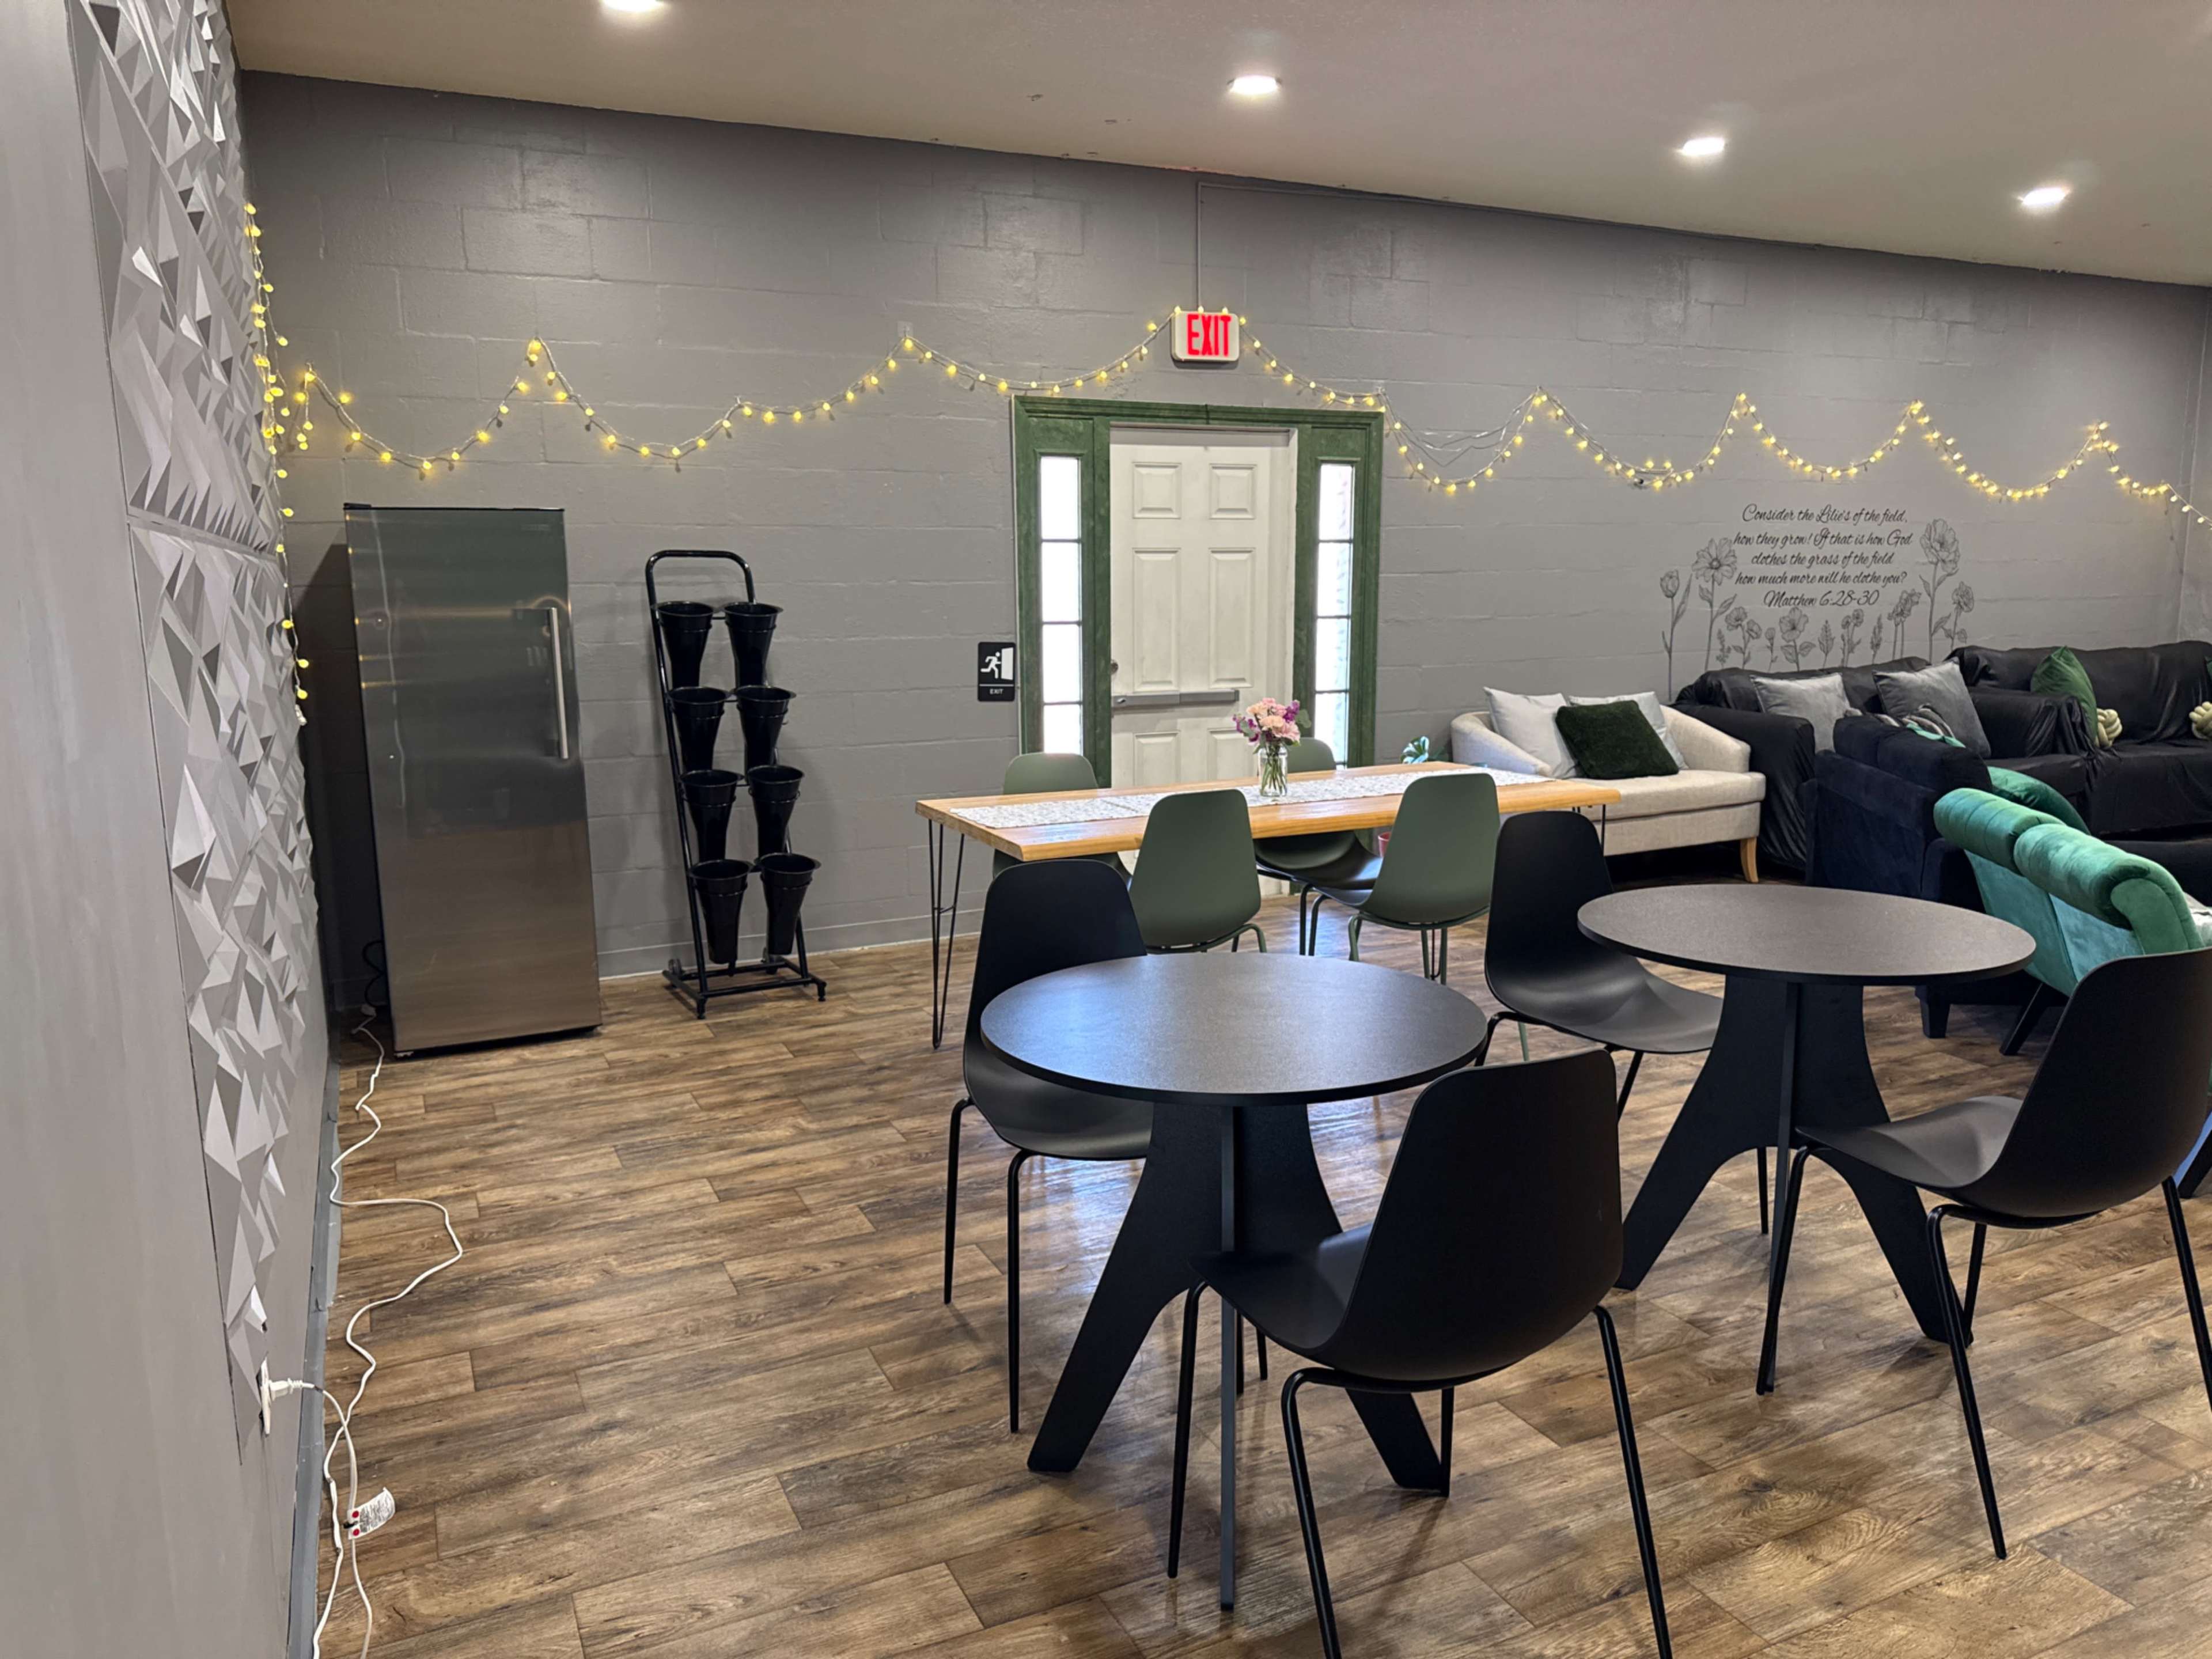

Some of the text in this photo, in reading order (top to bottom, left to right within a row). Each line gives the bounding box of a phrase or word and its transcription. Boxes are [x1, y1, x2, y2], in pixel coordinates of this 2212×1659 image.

[1187, 313, 1232, 357] EXIT
[1742, 503, 1796, 522] Consider
[1797, 508, 1815, 521] the
[1853, 507, 1865, 526] of
[1864, 509, 1880, 521] the
[1733, 528, 1913, 550] how they grow! If that is how God
[1751, 551, 1895, 569] clothes the grass of the field
[1734, 571, 1908, 588] how much more will he clothe you?
[1764, 589, 1880, 608] Matthew 6:28-30
